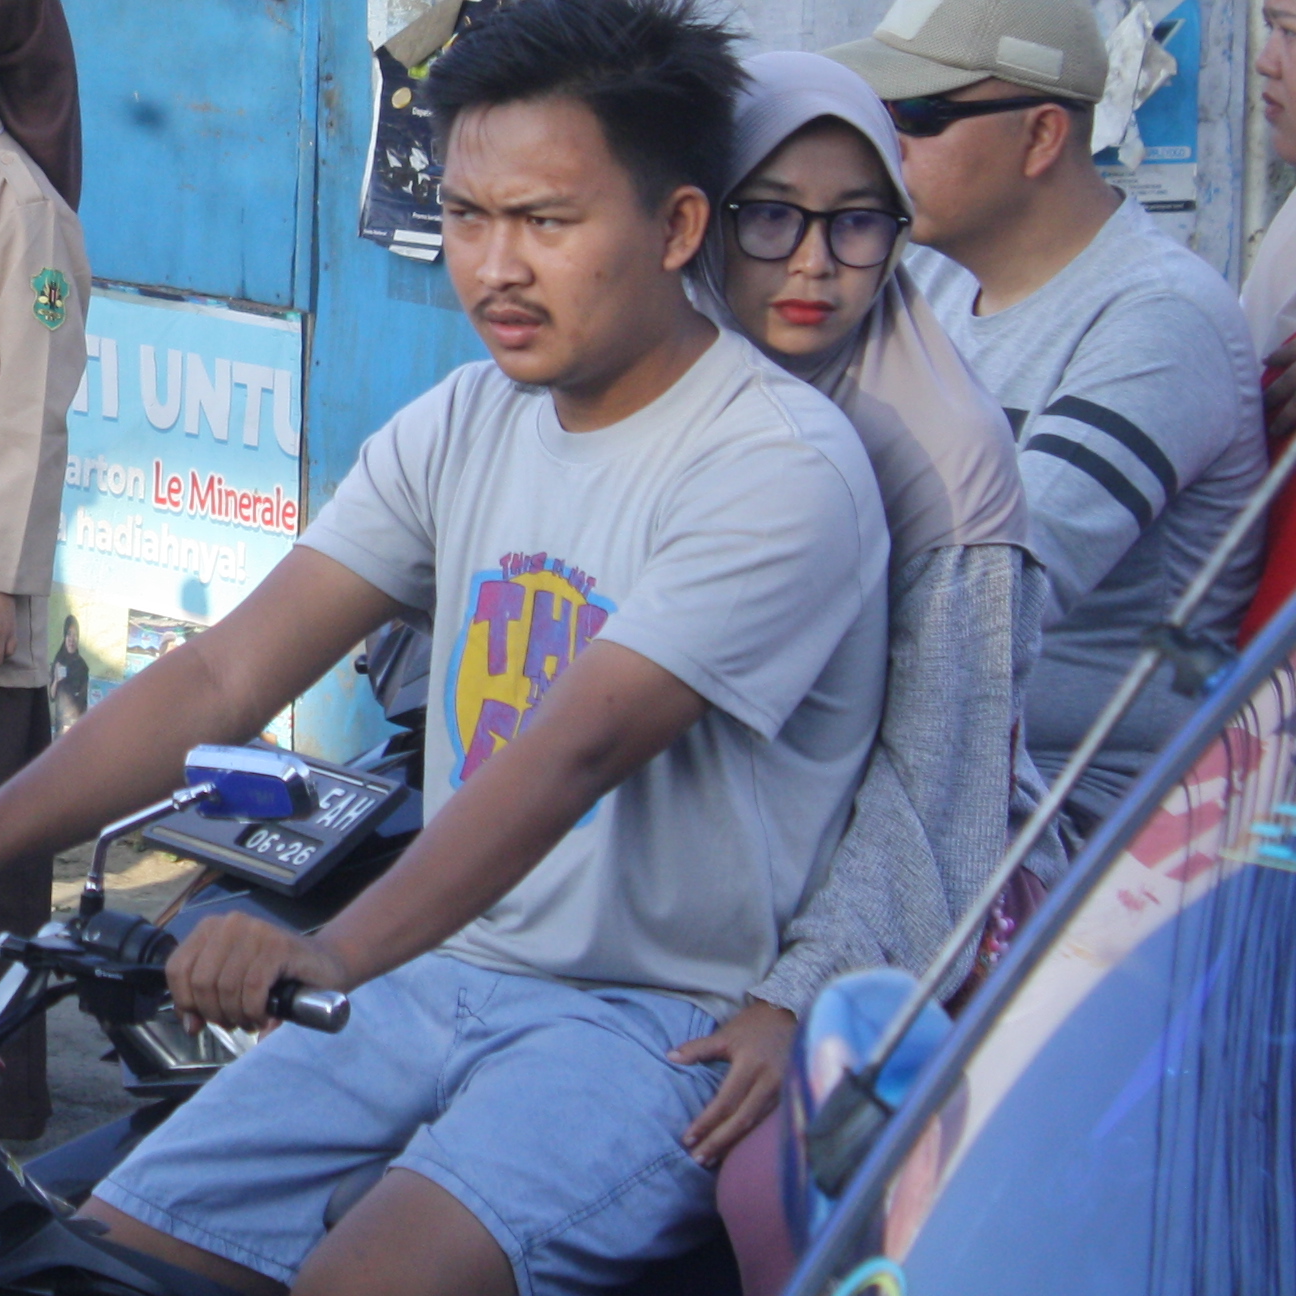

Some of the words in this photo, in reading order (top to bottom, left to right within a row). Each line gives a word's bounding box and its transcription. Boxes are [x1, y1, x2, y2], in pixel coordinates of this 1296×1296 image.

[152, 459, 185, 512] Le
[188, 469, 298, 535] Minerale
[76, 506, 247, 584] hadiahnya!
